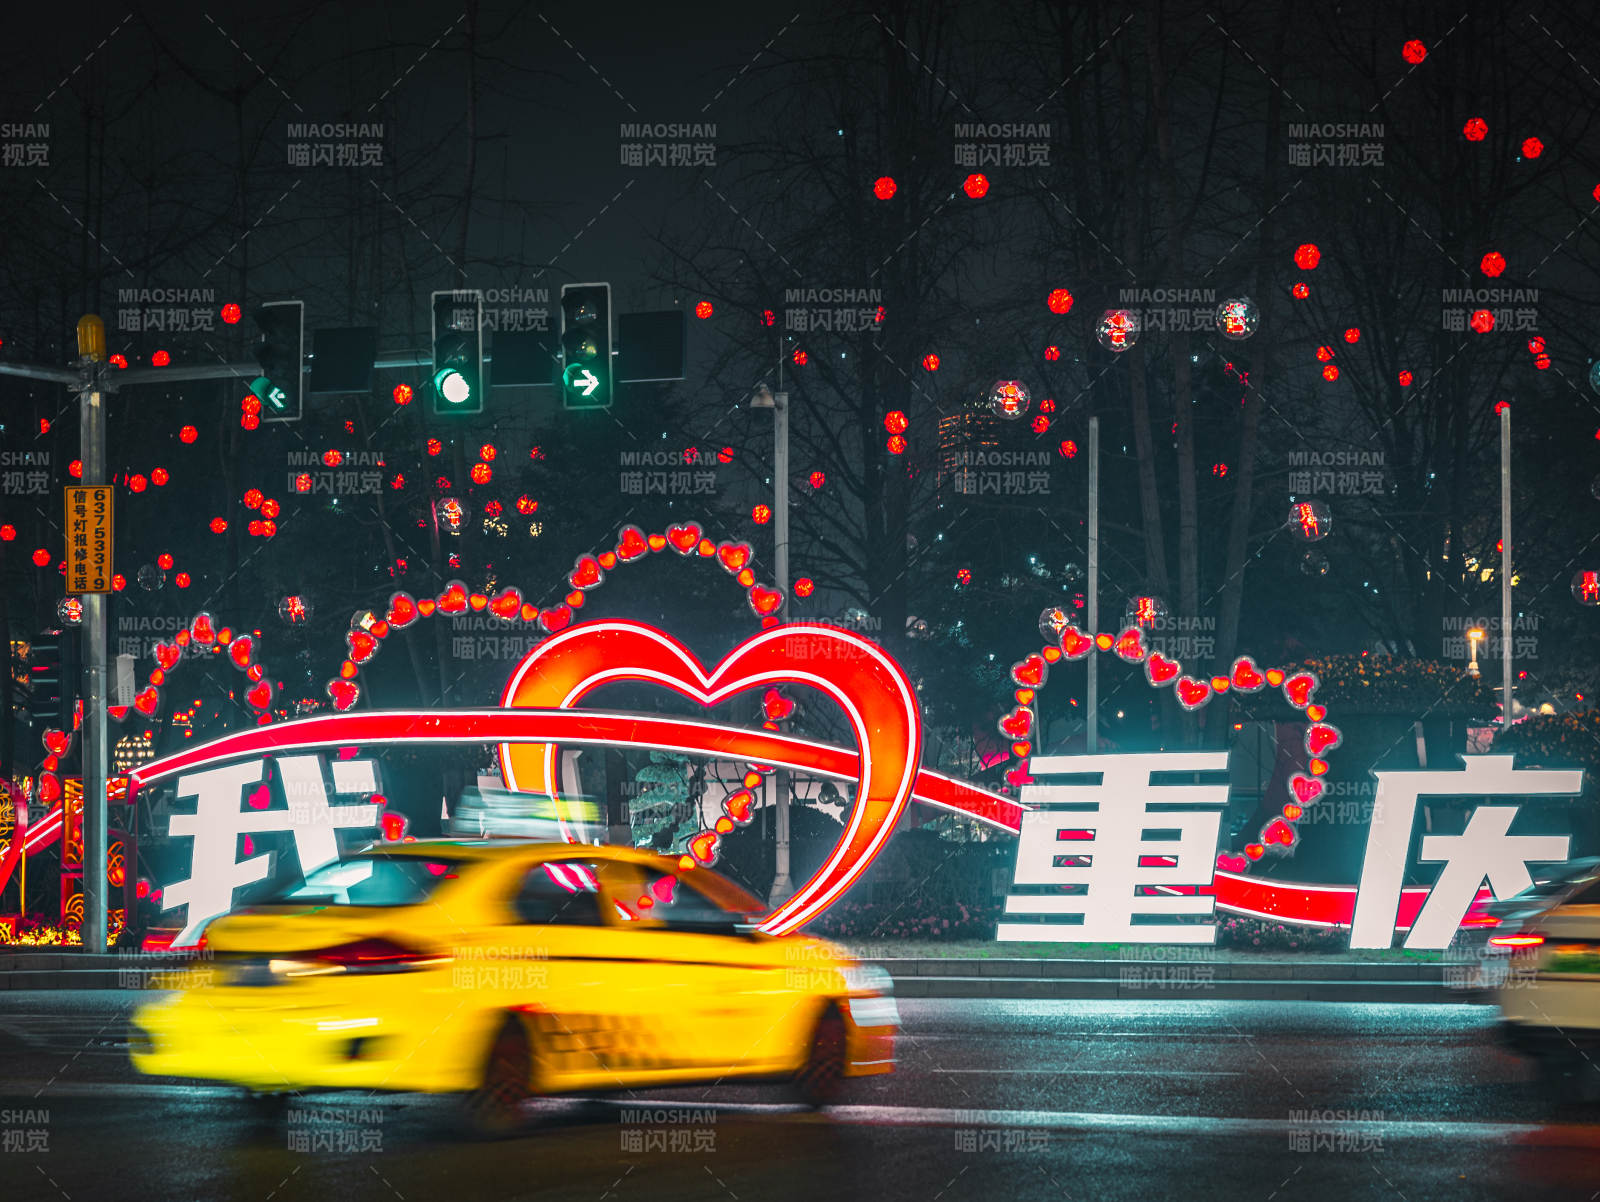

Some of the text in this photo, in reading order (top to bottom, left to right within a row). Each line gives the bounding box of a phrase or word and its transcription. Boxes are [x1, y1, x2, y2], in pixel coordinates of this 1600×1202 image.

[73, 490, 87, 590] 信号灯报修电话
[94, 490, 105, 589] 63753319
